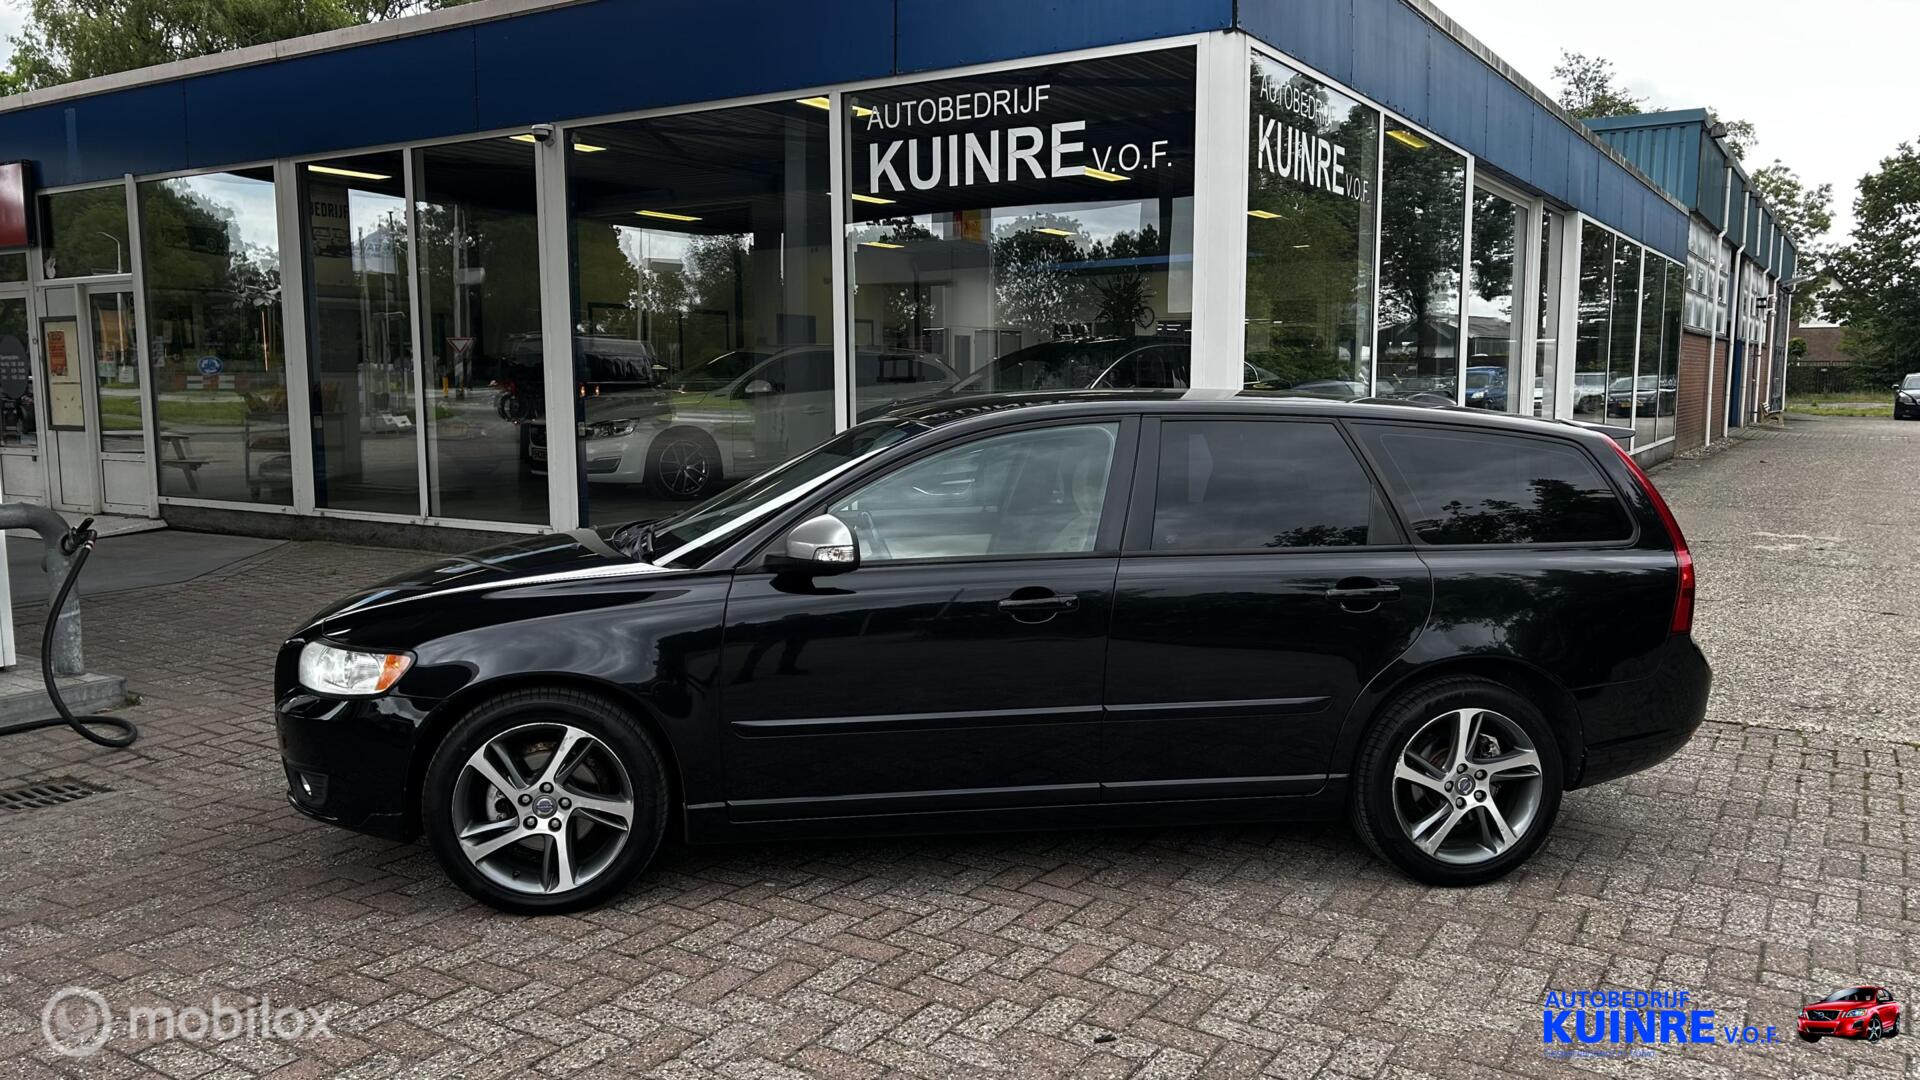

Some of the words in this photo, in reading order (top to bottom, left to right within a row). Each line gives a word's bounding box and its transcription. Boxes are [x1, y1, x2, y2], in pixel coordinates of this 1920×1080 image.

[867, 84, 1051, 130] AUTOBEDRIJF
[869, 119, 1086, 194] KUINRE
[1092, 139, 1172, 172] V.O.F.
[1258, 114, 1345, 195] KUINRE
[1345, 173, 1370, 203] V.O.F.
